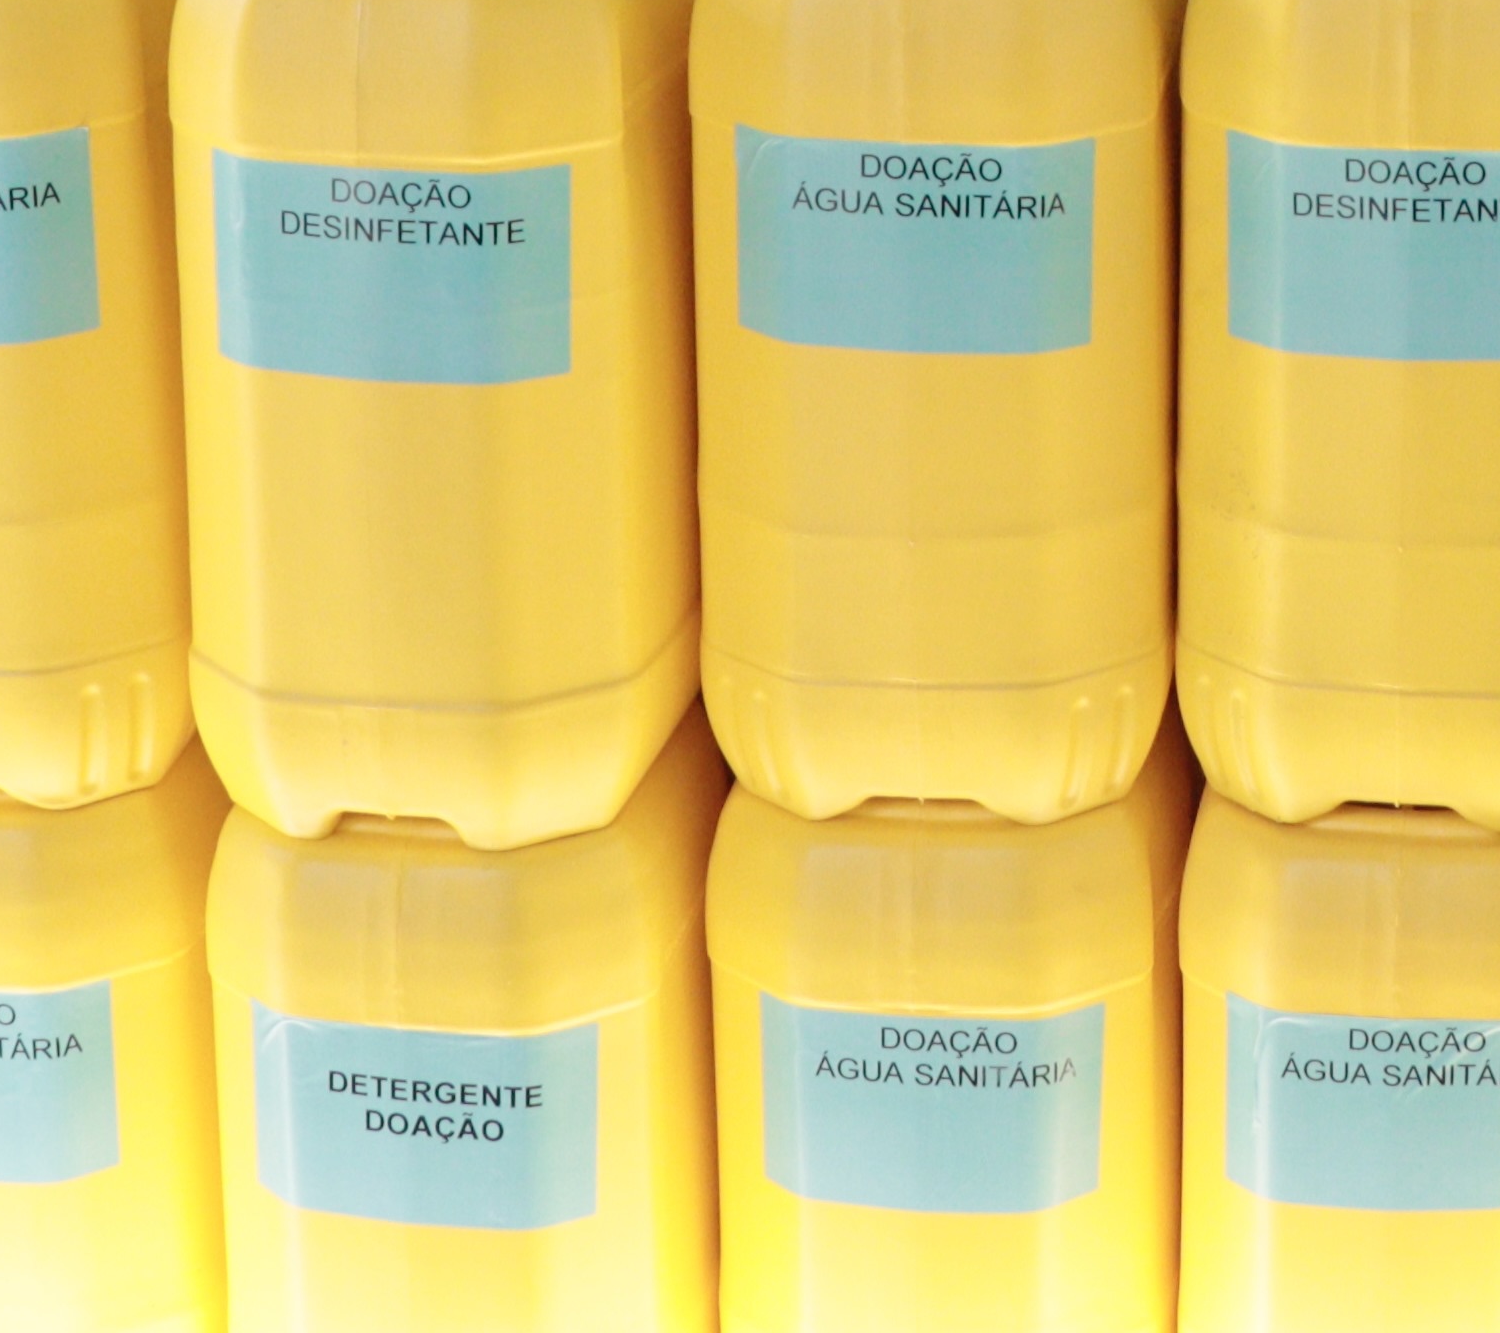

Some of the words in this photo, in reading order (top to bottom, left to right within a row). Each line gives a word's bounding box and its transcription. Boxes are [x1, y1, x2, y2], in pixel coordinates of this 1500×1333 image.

[860, 152, 1002, 188] DOAÇÃO
[1345, 157, 1486, 192] DOAÇÃO
[330, 176, 472, 213] DOAÇÃO
[792, 181, 884, 216] ÁGUA
[895, 190, 1066, 220] SANITÁRIA
[280, 209, 525, 247] DESINFETANTE
[881, 1025, 1019, 1059] DOAÇÃO
[1348, 1026, 1486, 1059] DOAÇÃO
[815, 1051, 903, 1084] ÁGUA
[914, 1057, 1077, 1089] SANITÁRIA
[1281, 1052, 1372, 1085] ÁGUA
[328, 1069, 543, 1110] DETERGENTE
[364, 1109, 504, 1144] DOAÇÃO
